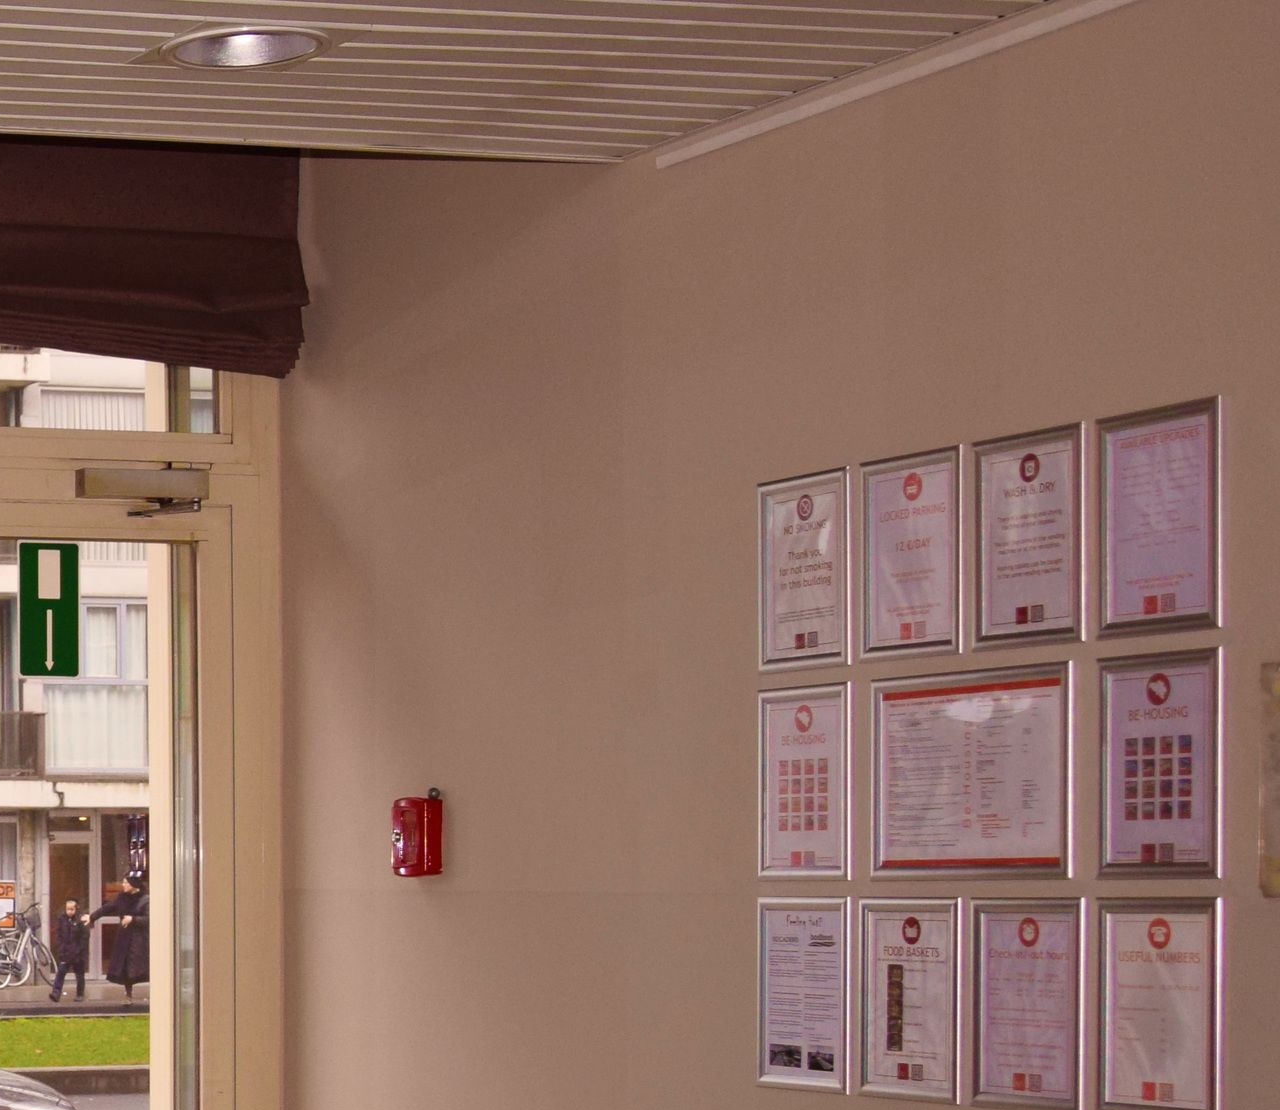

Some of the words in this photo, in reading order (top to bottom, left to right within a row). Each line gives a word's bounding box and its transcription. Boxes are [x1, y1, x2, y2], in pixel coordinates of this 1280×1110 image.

[1004, 486, 1027, 498] WASH
[1039, 482, 1056, 493] DRY
[879, 508, 909, 523] LOCKED
[911, 502, 946, 518] PARKING
[783, 523, 793, 535] NO
[895, 542, 905, 552] 12
[788, 549, 809, 560] Thank
[790, 565, 802, 575] not
[804, 560, 833, 574] smoking
[803, 574, 832, 588] building
[1128, 706, 1189, 721] BE-HOUSING
[781, 733, 826, 746] BE-HOUSING
[883, 946, 904, 957] FOOD
[906, 947, 940, 958] BASKETS
[1118, 951, 1153, 963] USEFUL
[1155, 951, 1201, 963] NUMBERS
